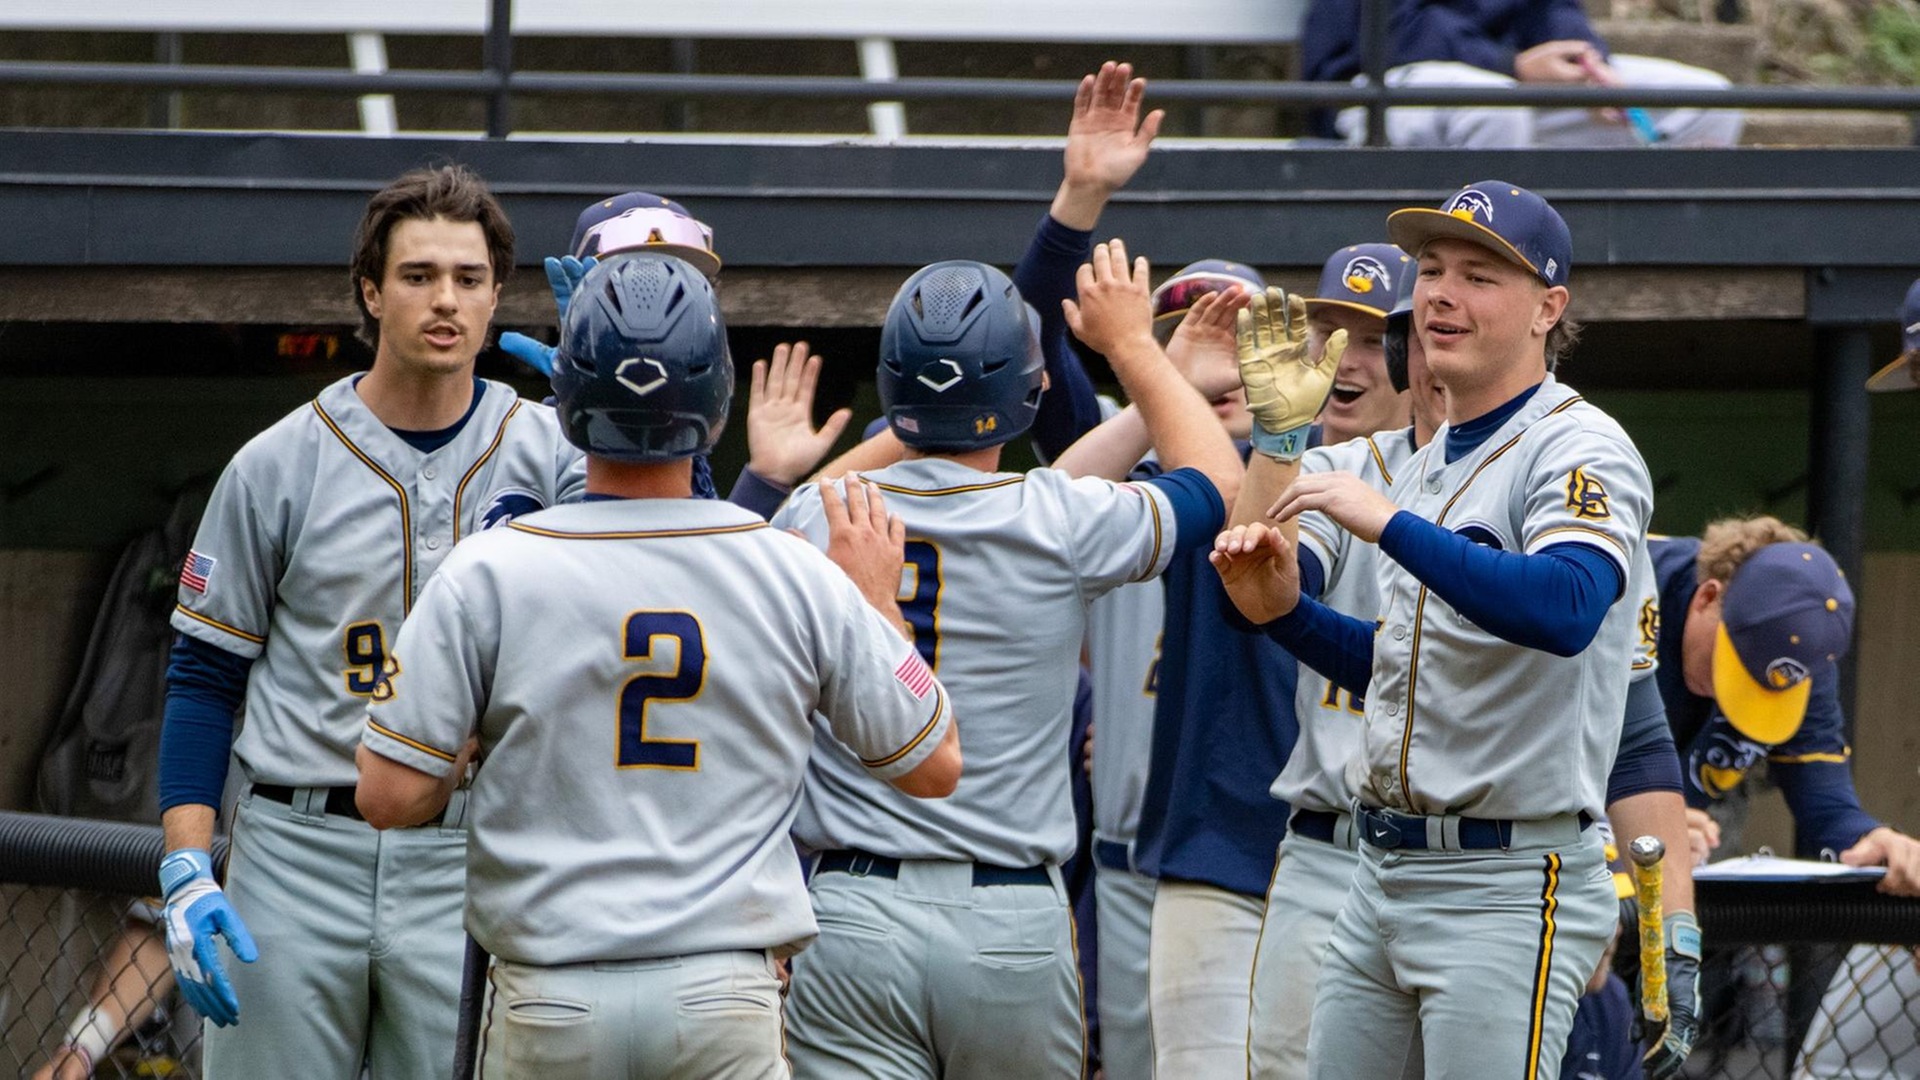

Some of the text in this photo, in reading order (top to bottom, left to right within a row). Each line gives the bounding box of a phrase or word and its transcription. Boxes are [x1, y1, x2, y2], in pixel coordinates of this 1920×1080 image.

[975, 415, 996, 435] 14
[343, 618, 388, 698] 9
[615, 608, 710, 771] 2
